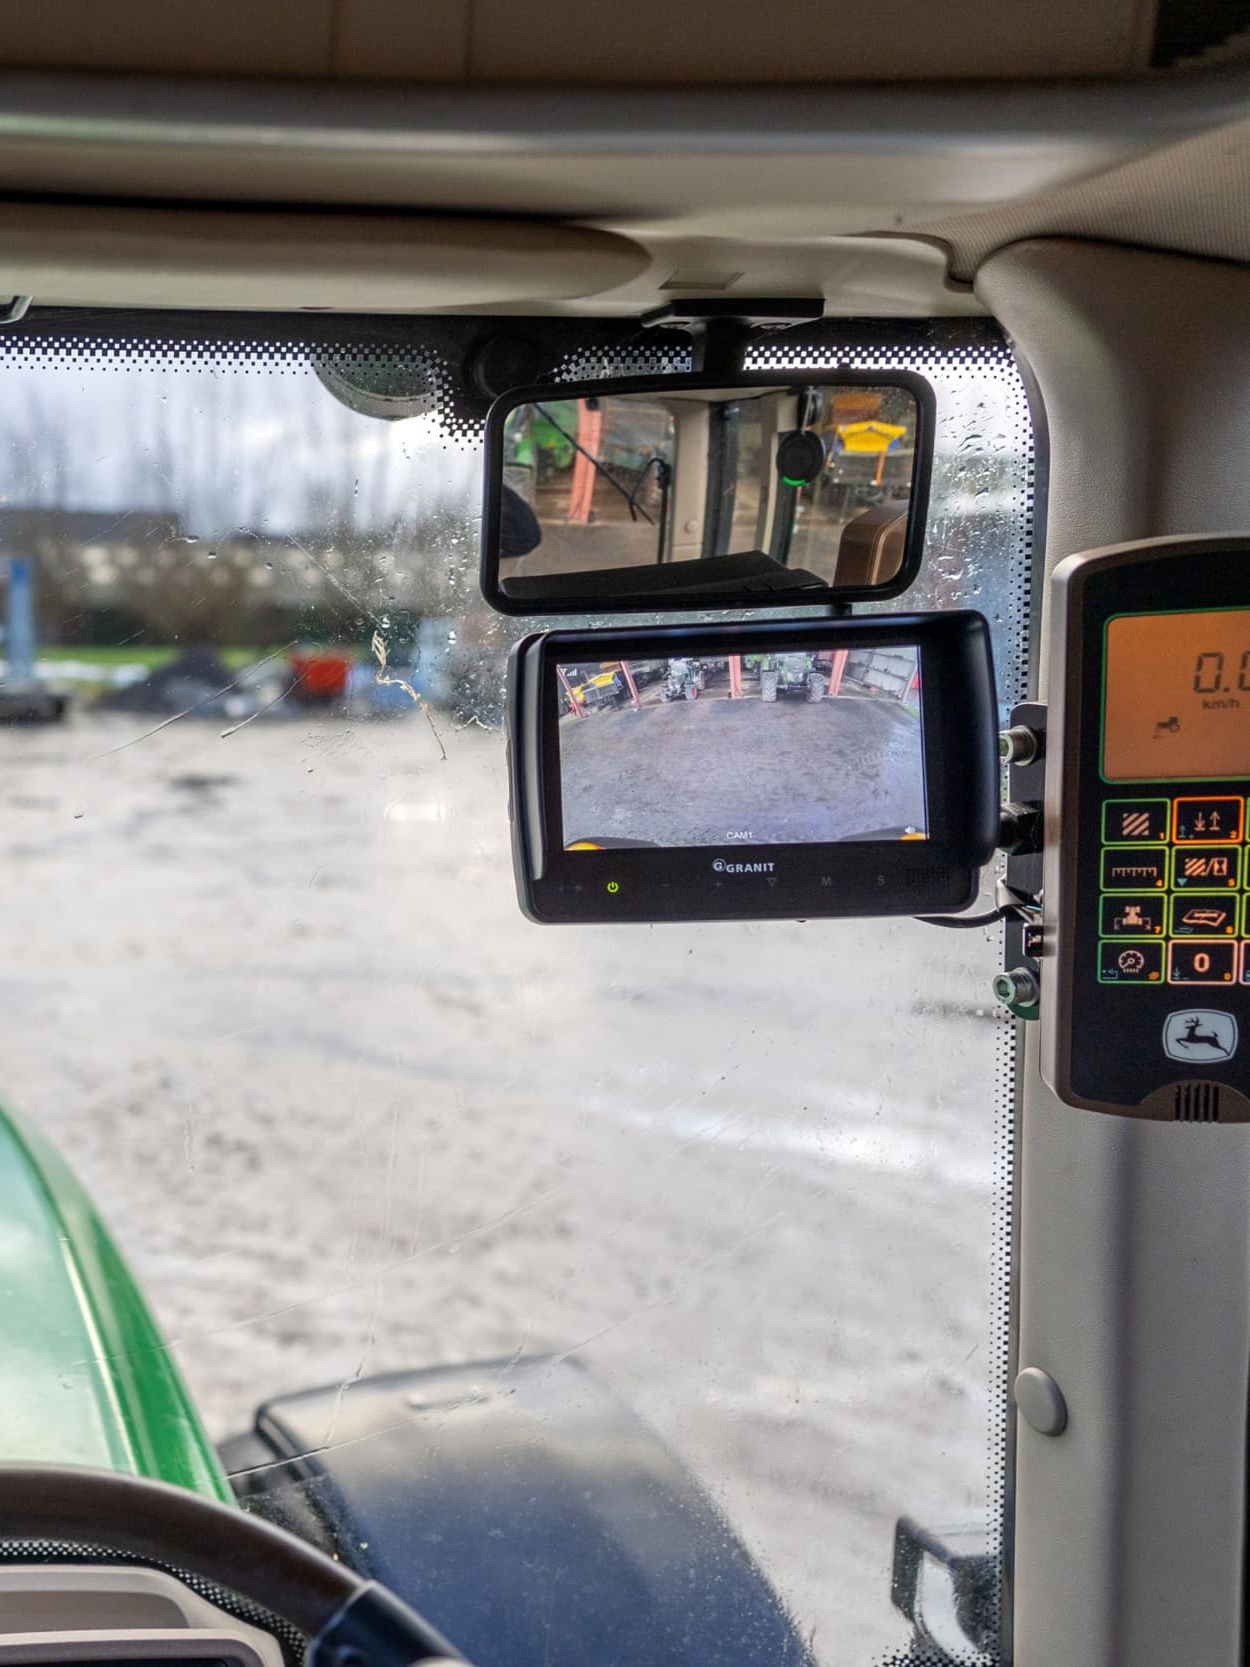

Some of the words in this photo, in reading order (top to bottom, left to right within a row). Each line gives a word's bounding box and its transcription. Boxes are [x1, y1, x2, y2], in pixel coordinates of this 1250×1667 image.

[1202, 698, 1241, 710] km/h
[726, 831, 753, 841] CAM1
[726, 862, 775, 873] GRANIT
[1193, 952, 1210, 973] 0
